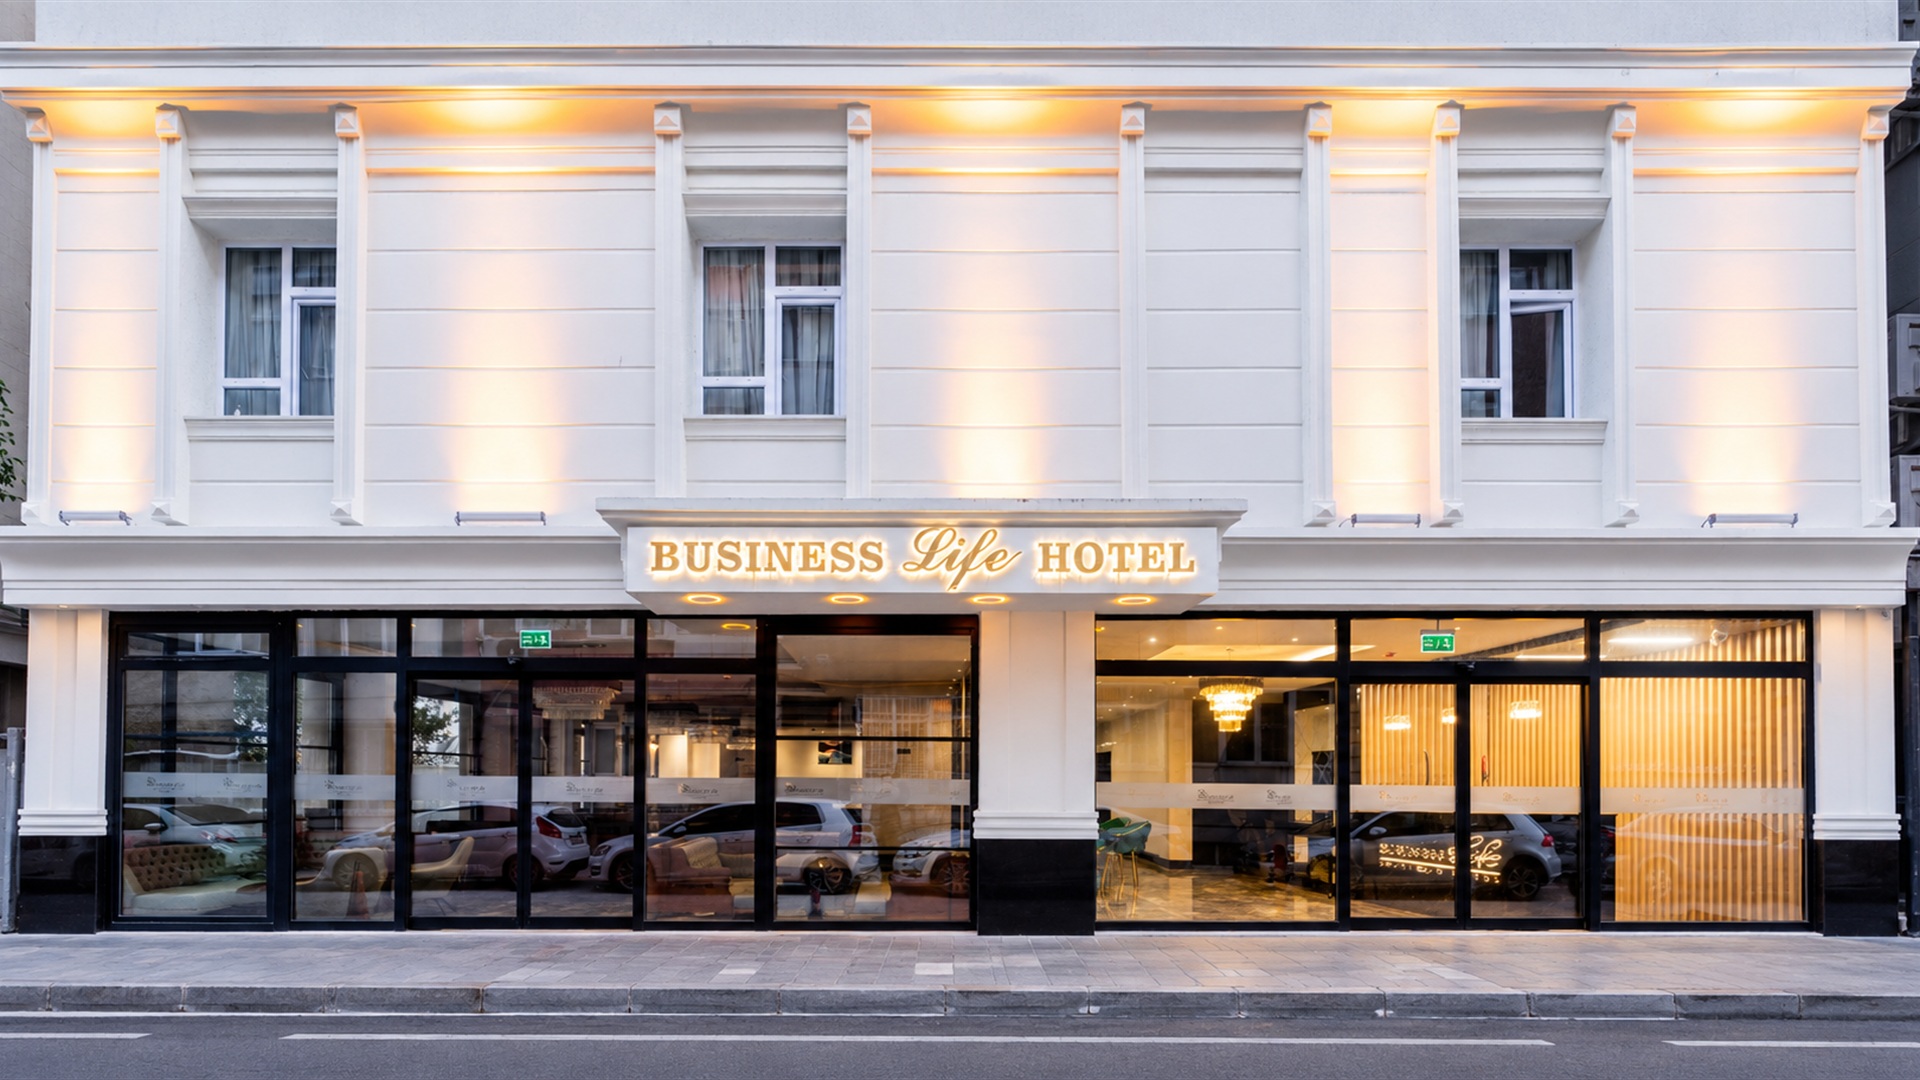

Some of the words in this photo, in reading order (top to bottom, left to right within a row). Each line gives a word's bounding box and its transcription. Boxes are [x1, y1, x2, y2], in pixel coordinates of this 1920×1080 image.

[650, 540, 884, 573] BUSINESS
[902, 527, 1023, 591] Life
[1037, 541, 1195, 573] HOTEL
